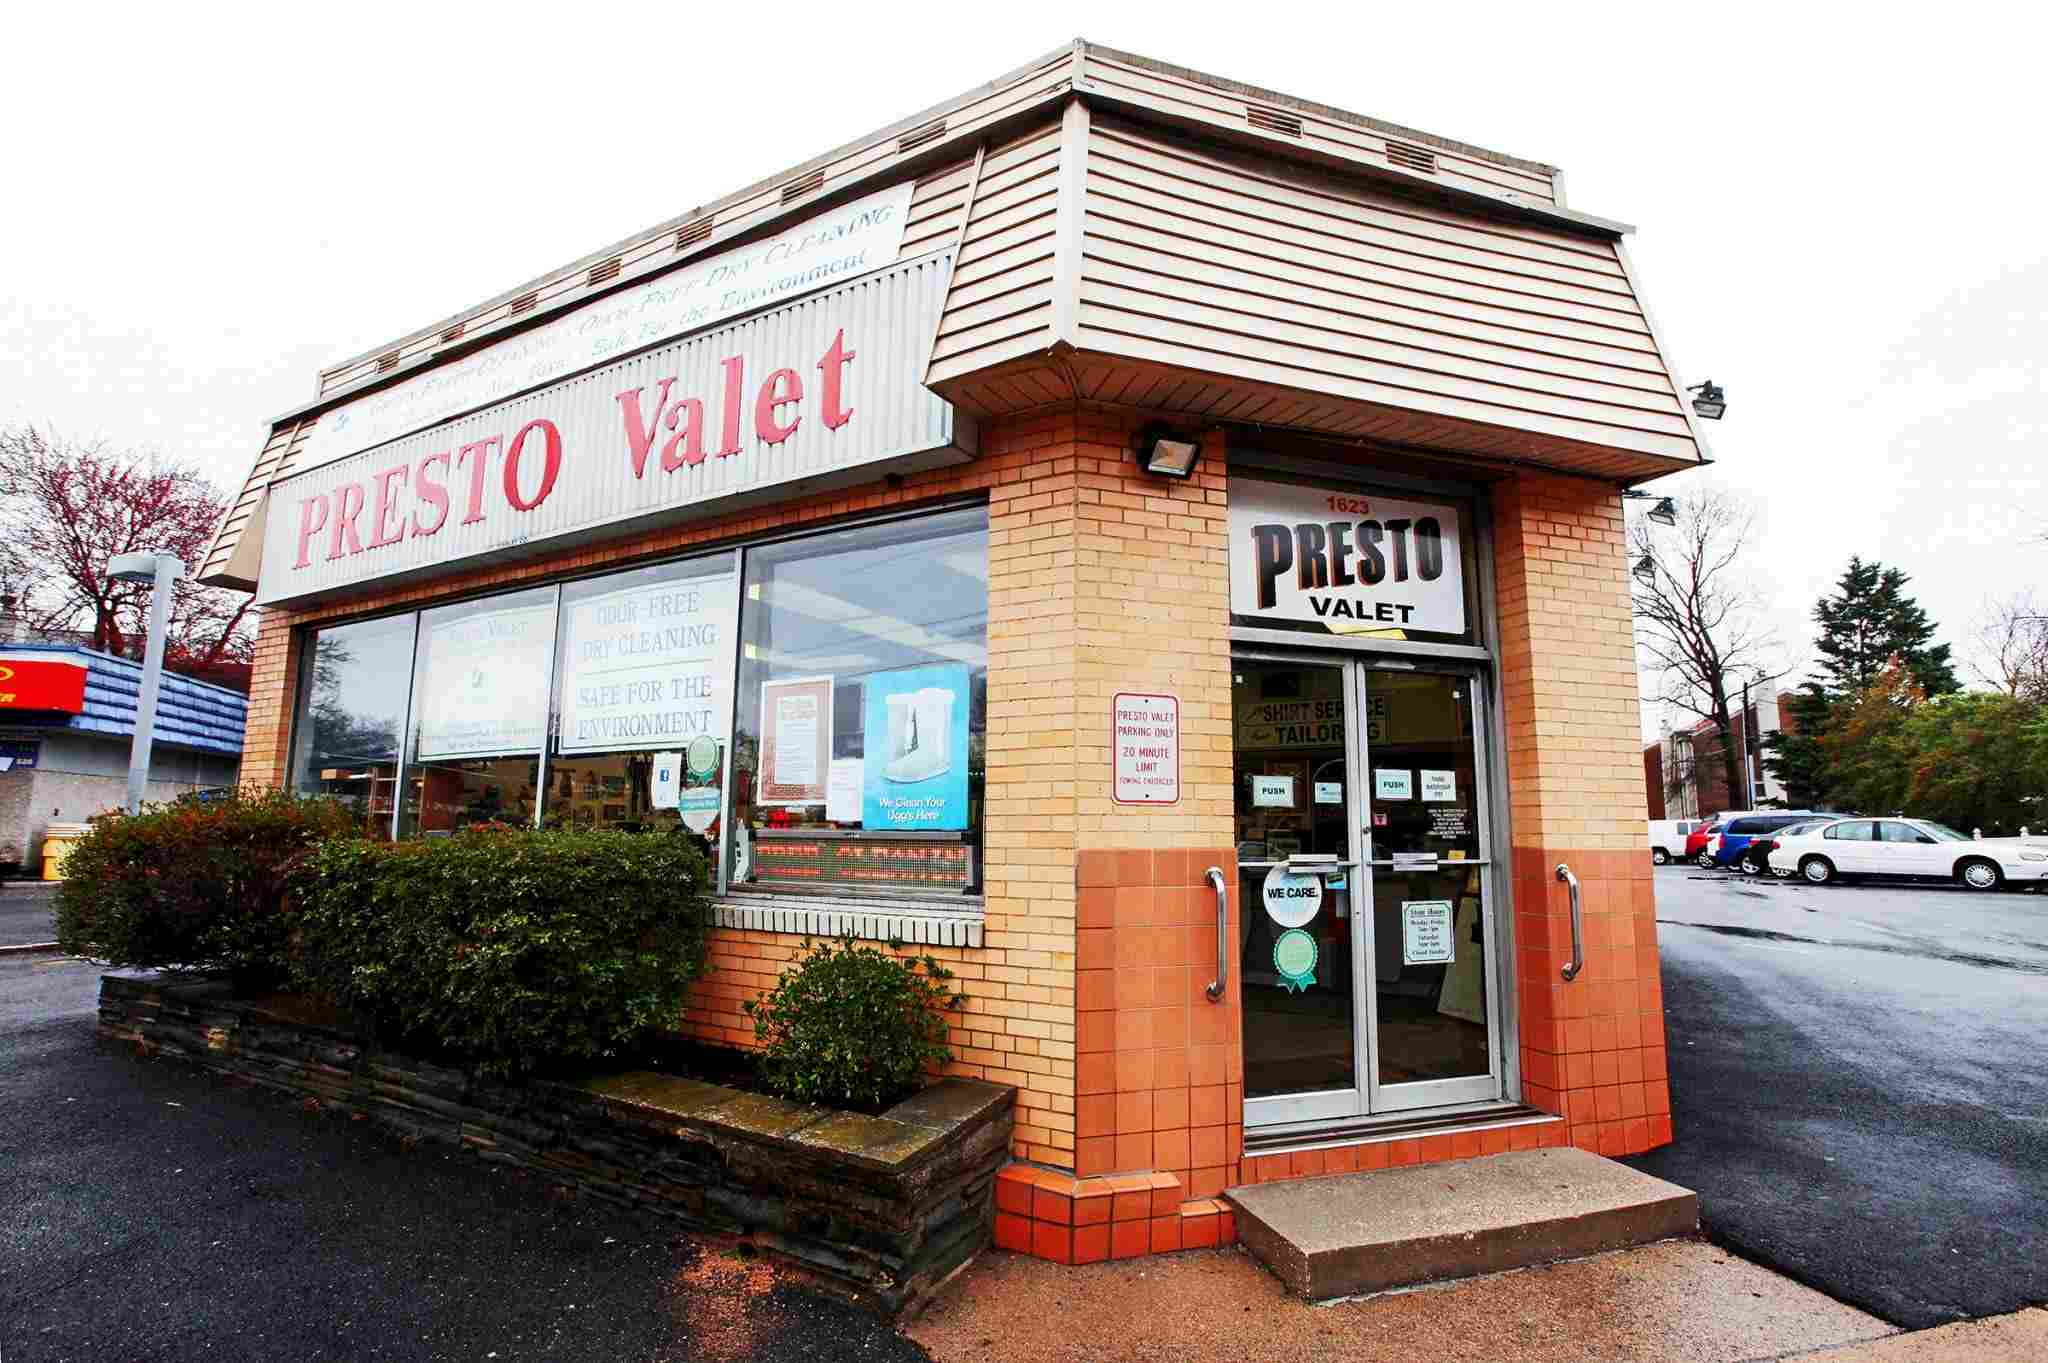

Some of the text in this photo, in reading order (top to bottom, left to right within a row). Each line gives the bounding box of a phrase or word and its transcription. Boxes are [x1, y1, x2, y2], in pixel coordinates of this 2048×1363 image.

[291, 418, 563, 570] PRESTO
[614, 328, 857, 480] Valet
[1326, 495, 1371, 515] 1623
[1250, 516, 1444, 609] PRESTO
[648, 591, 701, 618] FREE
[1309, 596, 1416, 624] VALET
[583, 624, 718, 659] DRY CLEANING
[579, 675, 713, 708] SAFE FOR THE
[1117, 710, 1174, 723] PRESTO VALET
[1263, 702, 1312, 722] SHIRT
[577, 709, 713, 740] ENVIRONMENT
[1118, 726, 1174, 738] PARKING ONLY
[1278, 722, 1381, 745] TAILORG
[1122, 746, 1169, 759] 20 MINUTE
[1135, 762, 1159, 773] LIMIT
[1261, 787, 1286, 795] PUSH
[1383, 781, 1405, 789] PUSH
[1267, 887, 1284, 898] WE
